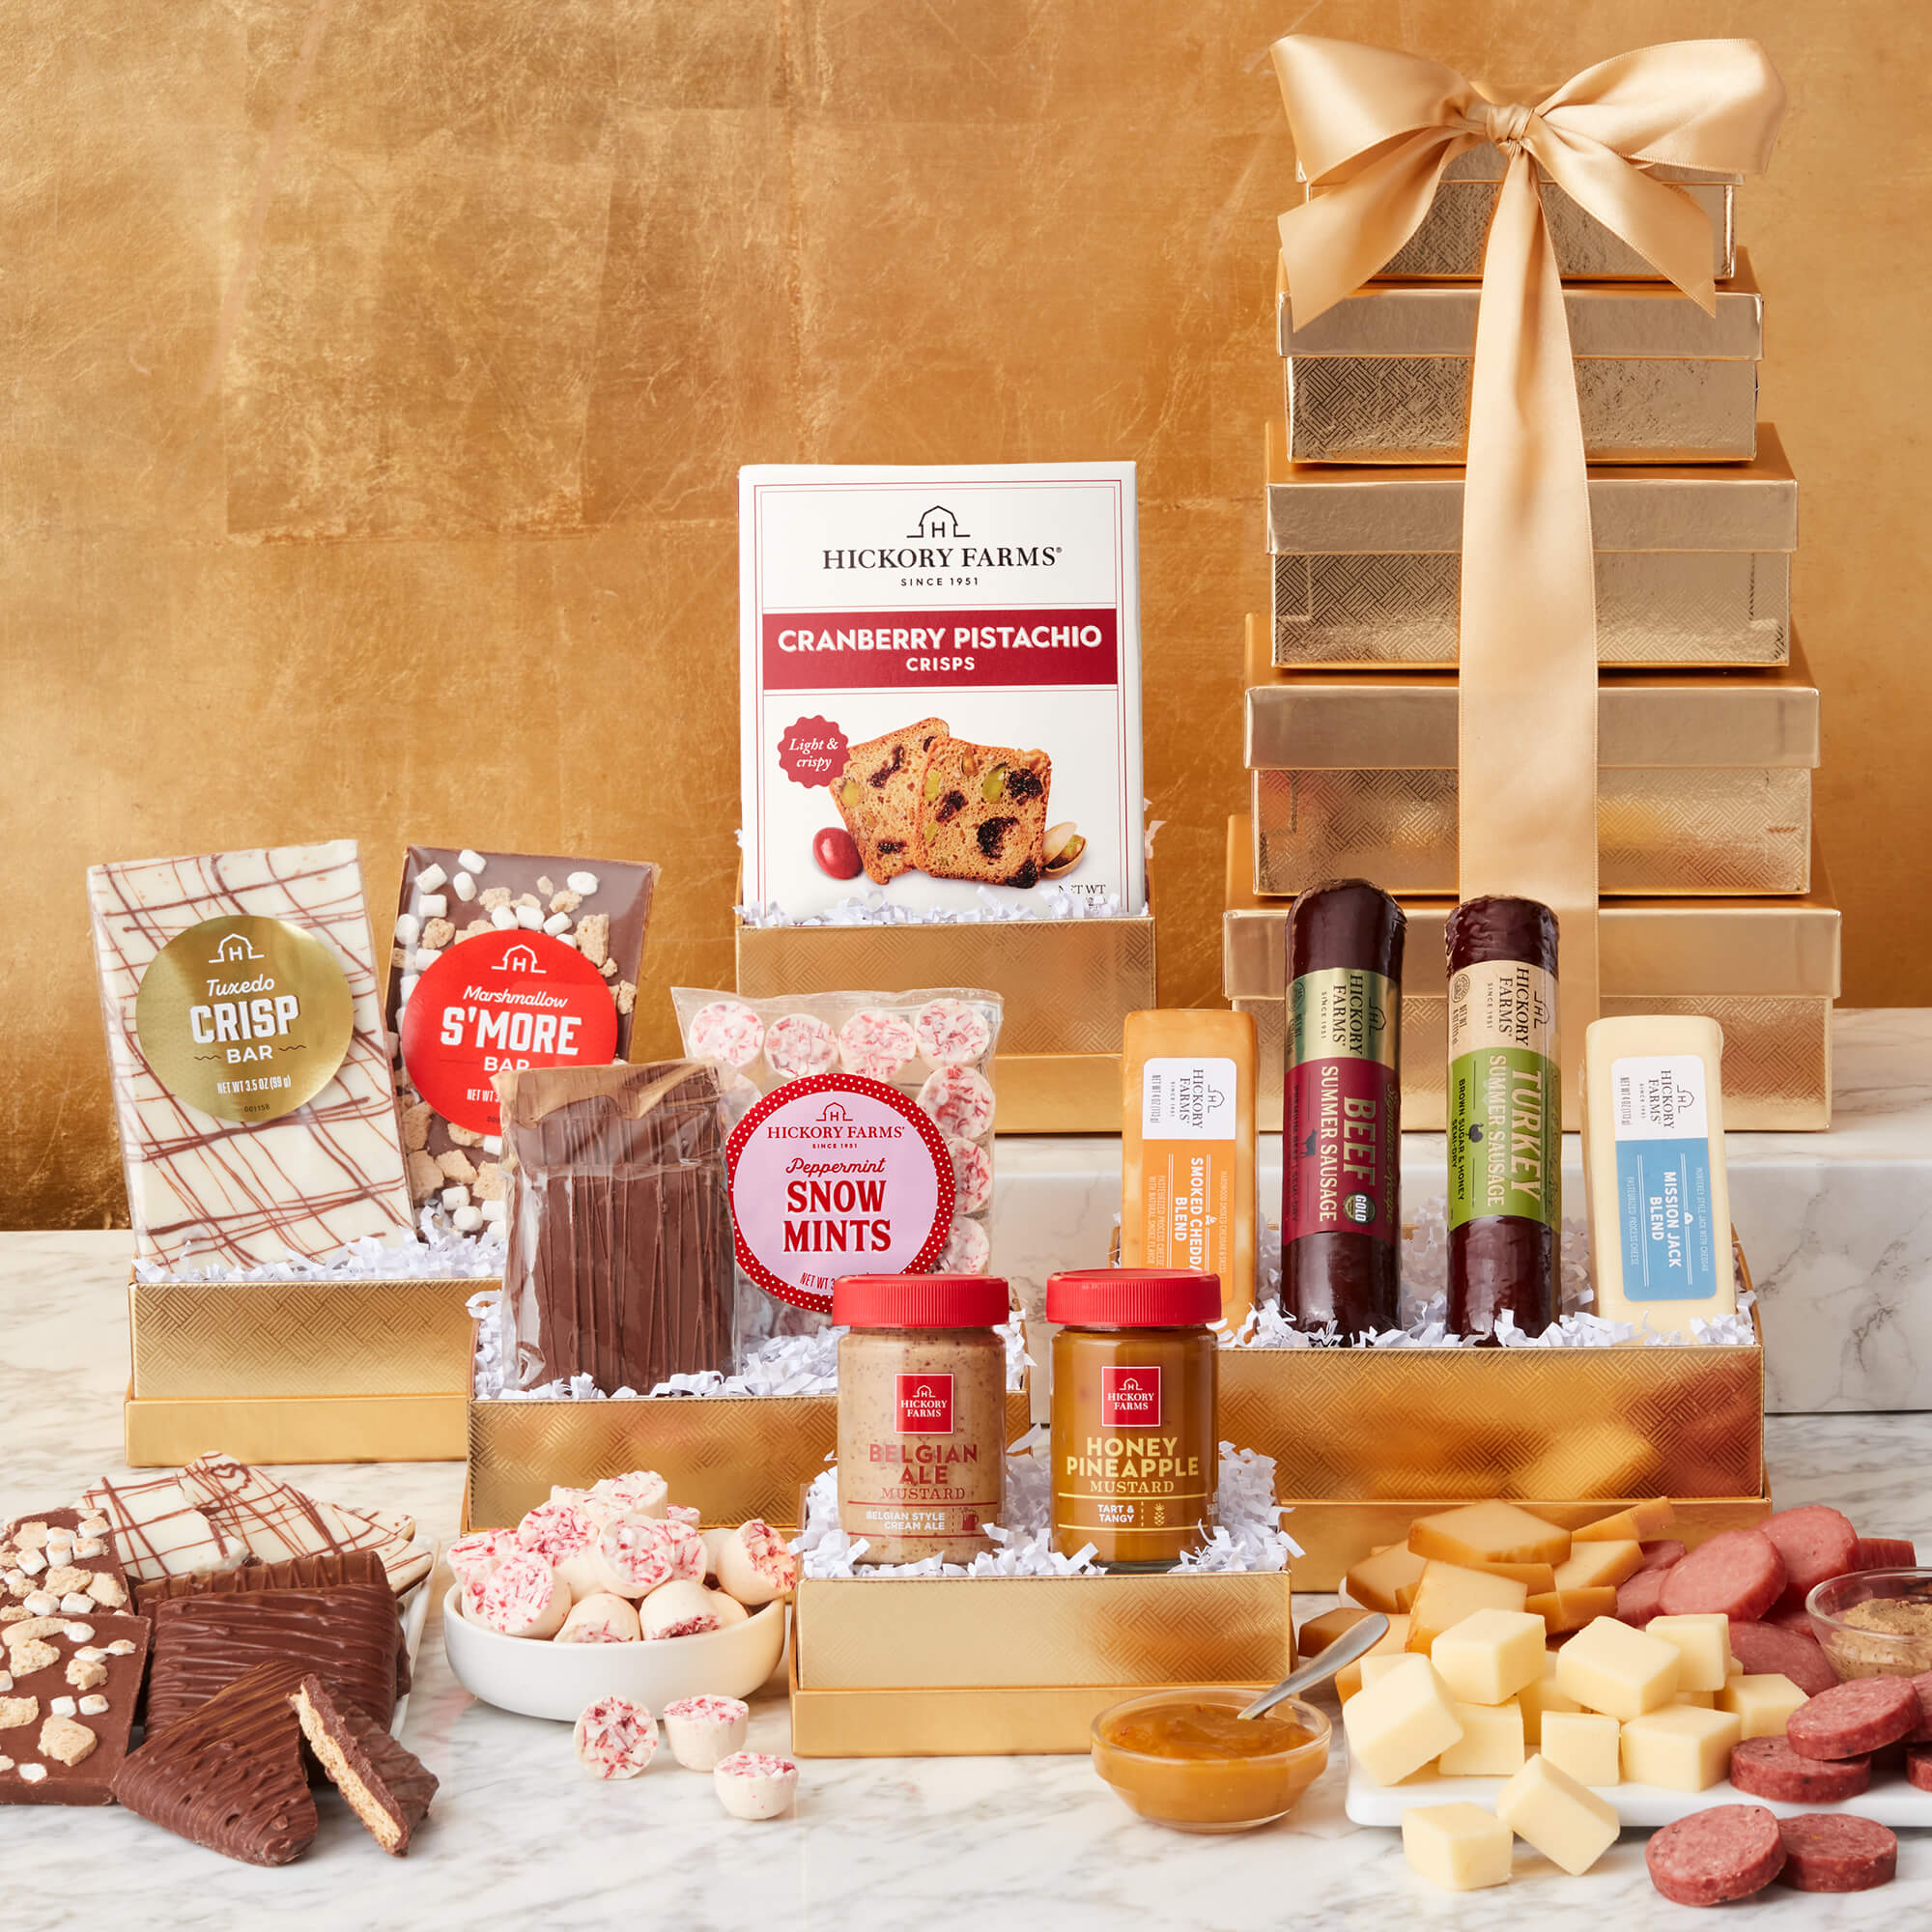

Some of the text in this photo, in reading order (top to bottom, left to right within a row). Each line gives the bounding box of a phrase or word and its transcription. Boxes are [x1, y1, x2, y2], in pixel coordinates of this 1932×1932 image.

[823, 548, 953, 569] HICKORY
[901, 577, 979, 587] SINCE 1951
[778, 625, 1103, 653] CRANBERRY PISTACHIO
[906, 656, 975, 671] CRISPS
[789, 737, 839, 755] Light &
[796, 756, 832, 771] crispy
[1085, 884, 1106, 895] WT
[206, 974, 275, 997] Tuxedo
[463, 985, 568, 1008] Marshmallow
[1516, 967, 1529, 1046] HICKORY
[189, 995, 300, 1044] CRISP
[1350, 975, 1364, 1055] HICKORY
[440, 1006, 582, 1056] S'MORE
[227, 1045, 274, 1064] BAR
[217, 1081, 231, 1094] NET
[232, 1080, 244, 1093] WT
[245, 1079, 258, 1092] 3.5
[258, 1077, 269, 1090] OZ
[1151, 1075, 1161, 1084] NET
[1620, 1077, 1630, 1086] NET
[467, 1089, 481, 1101] NET
[482, 1090, 494, 1102] WT
[1192, 1069, 1204, 1129] HICKORY
[1661, 1070, 1674, 1129] HICKORY
[767, 1126, 843, 1139] HICKORY
[1343, 1096, 1376, 1186] BEEF
[1487, 1055, 1507, 1207] SUMMER SAUSAGE
[1510, 1069, 1542, 1202] TURKEY
[1320, 1066, 1339, 1222] SUMMER SAUSAGE
[1383, 1083, 1399, 1224] Signature Recipe
[786, 1157, 886, 1178] Peppermint
[1190, 1157, 1203, 1215] SMOKED
[787, 1180, 887, 1213] SNOW
[1355, 1195, 1367, 1222] GOLD
[1650, 1197, 1664, 1240] BLEND
[1174, 1197, 1188, 1242] BLEND
[1664, 1171, 1681, 1268] MISSION JACK
[1698, 1215, 1707, 1229] JACK
[783, 1219, 891, 1253] MINTS
[1699, 1230, 1708, 1245] WITH
[1700, 1246, 1709, 1272] CHEDDAR
[800, 1272, 816, 1287] NET
[817, 1276, 828, 1290] WT
[900, 1400, 948, 1408] HICKORY
[1107, 1393, 1154, 1402] HICKORY
[1114, 1402, 1149, 1411] FARMS
[907, 1409, 942, 1417] FARMS
[869, 1443, 978, 1464] BELGIAN
[1087, 1437, 1178, 1457] HONEY
[899, 1465, 949, 1484] ALE
[1066, 1456, 1199, 1478] PINEAPPLE
[881, 1487, 965, 1500] MUSTARD
[1090, 1480, 1175, 1493] MUSTARD
[866, 1511, 945, 1521] BELGIAN STYLE
[1097, 1504, 1134, 1513] TART &
[1099, 1514, 1134, 1523] TANGY
[884, 1521, 945, 1531] CREAM ALE
